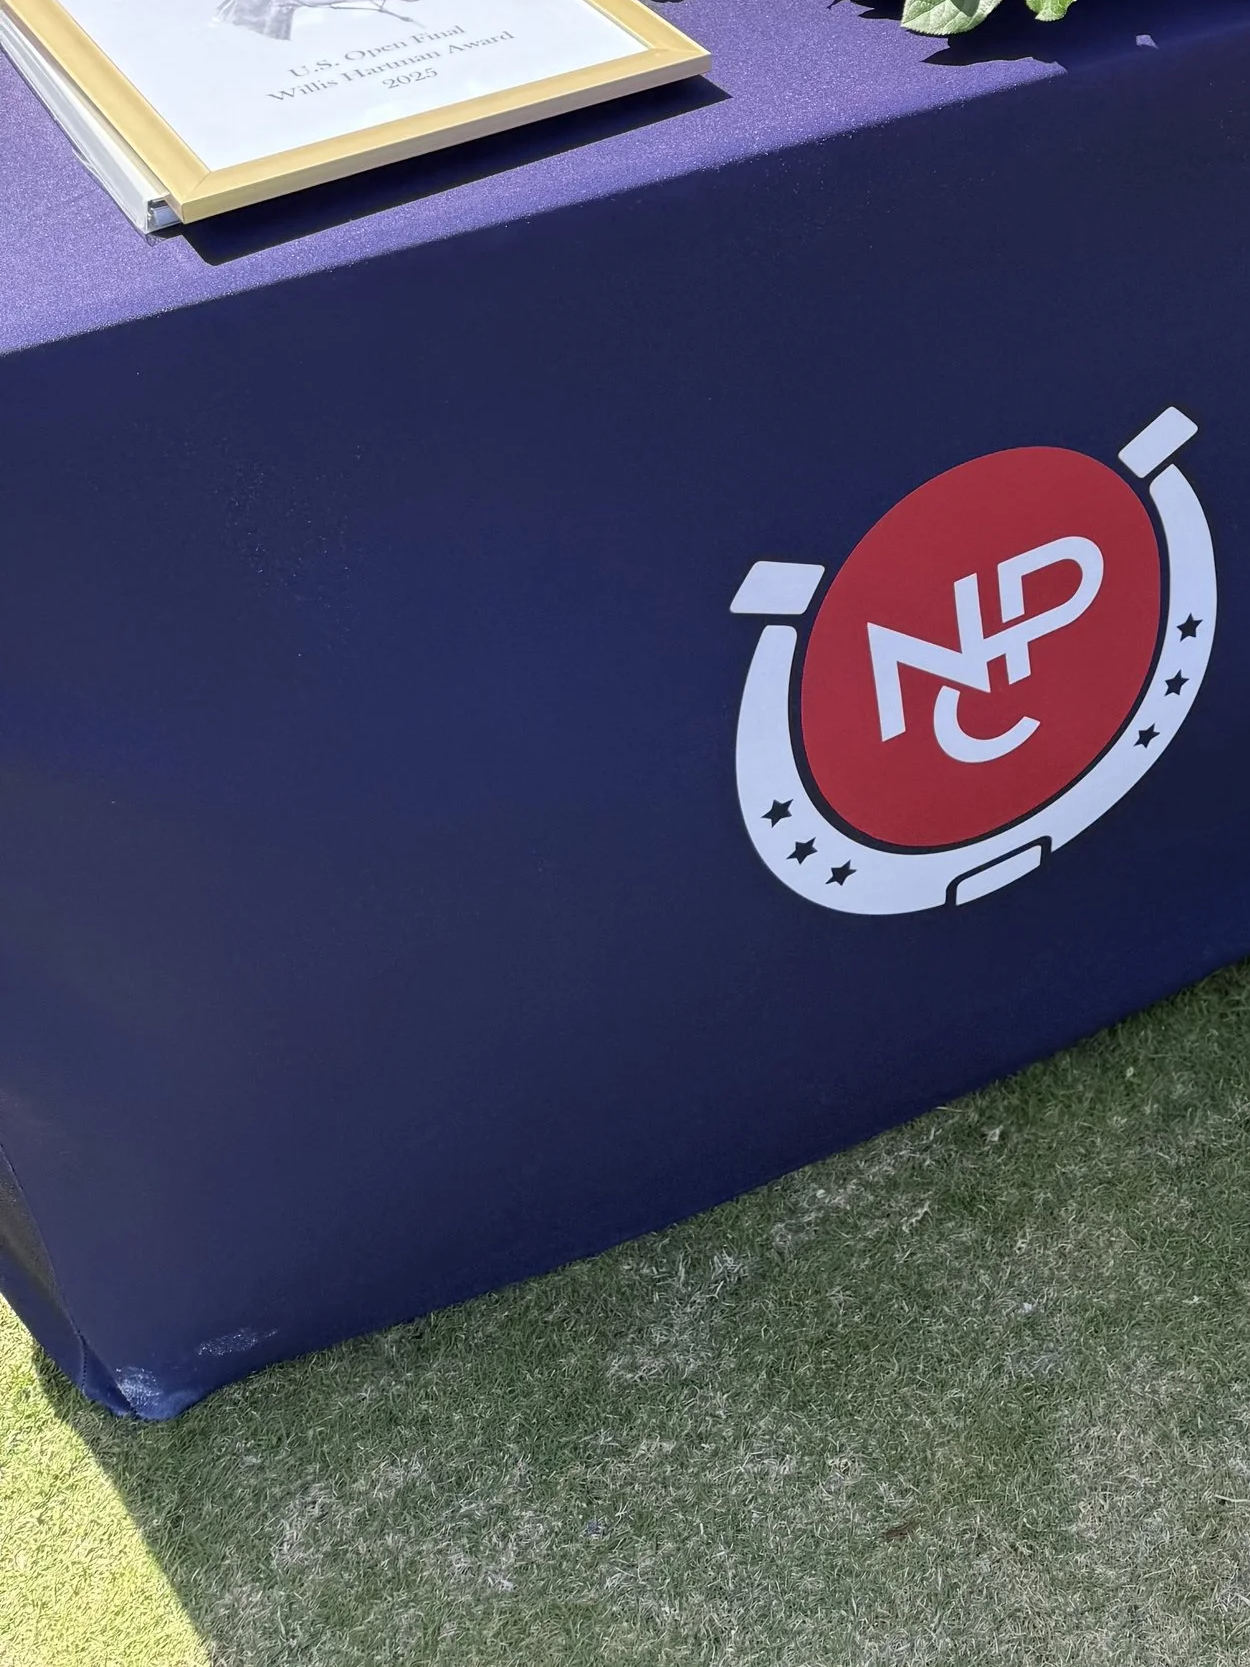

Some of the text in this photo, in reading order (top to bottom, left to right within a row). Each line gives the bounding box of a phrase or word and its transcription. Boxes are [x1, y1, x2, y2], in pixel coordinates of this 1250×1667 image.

[267, 30, 516, 102] Willis Hartman Award
[289, 25, 467, 78] U.S. Open Final
[382, 67, 439, 90] 2025
[867, 535, 1104, 763] NPC
